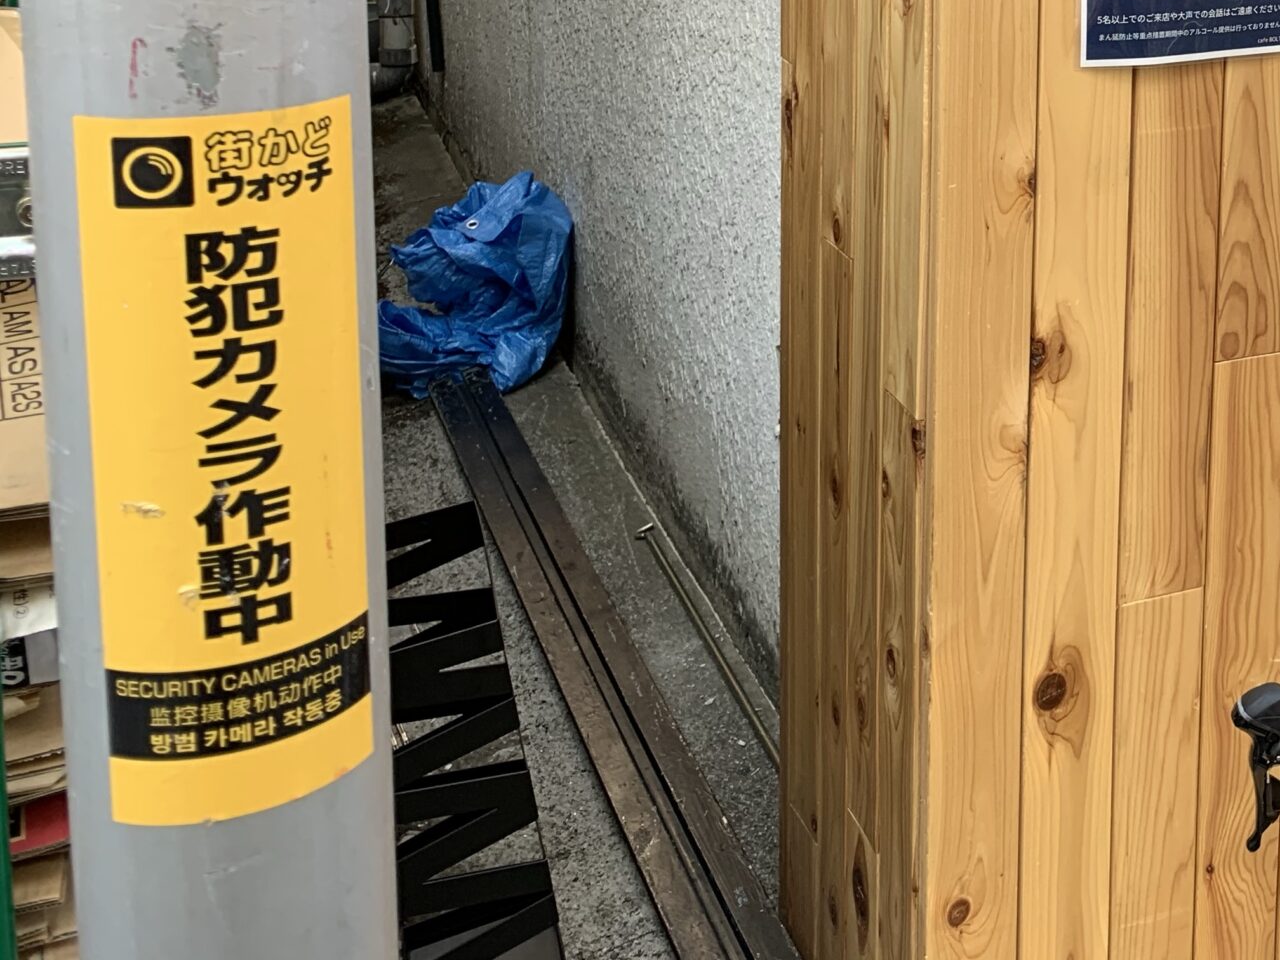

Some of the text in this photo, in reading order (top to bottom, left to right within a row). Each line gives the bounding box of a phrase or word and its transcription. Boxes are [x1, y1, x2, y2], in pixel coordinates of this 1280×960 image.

[205, 115, 332, 172] 街かど
[207, 156, 332, 207] ウォッチ
[2, 311, 32, 338] AM
[7, 345, 38, 375] AS
[10, 380, 43, 413] A2S
[184, 226, 292, 646] 防犯カメラ作動中
[115, 625, 366, 699] SECURITY CAMERAS in Use
[150, 664, 342, 727] 监控摄像机动作中
[150, 689, 342, 755] 방범 카메라 작동중
